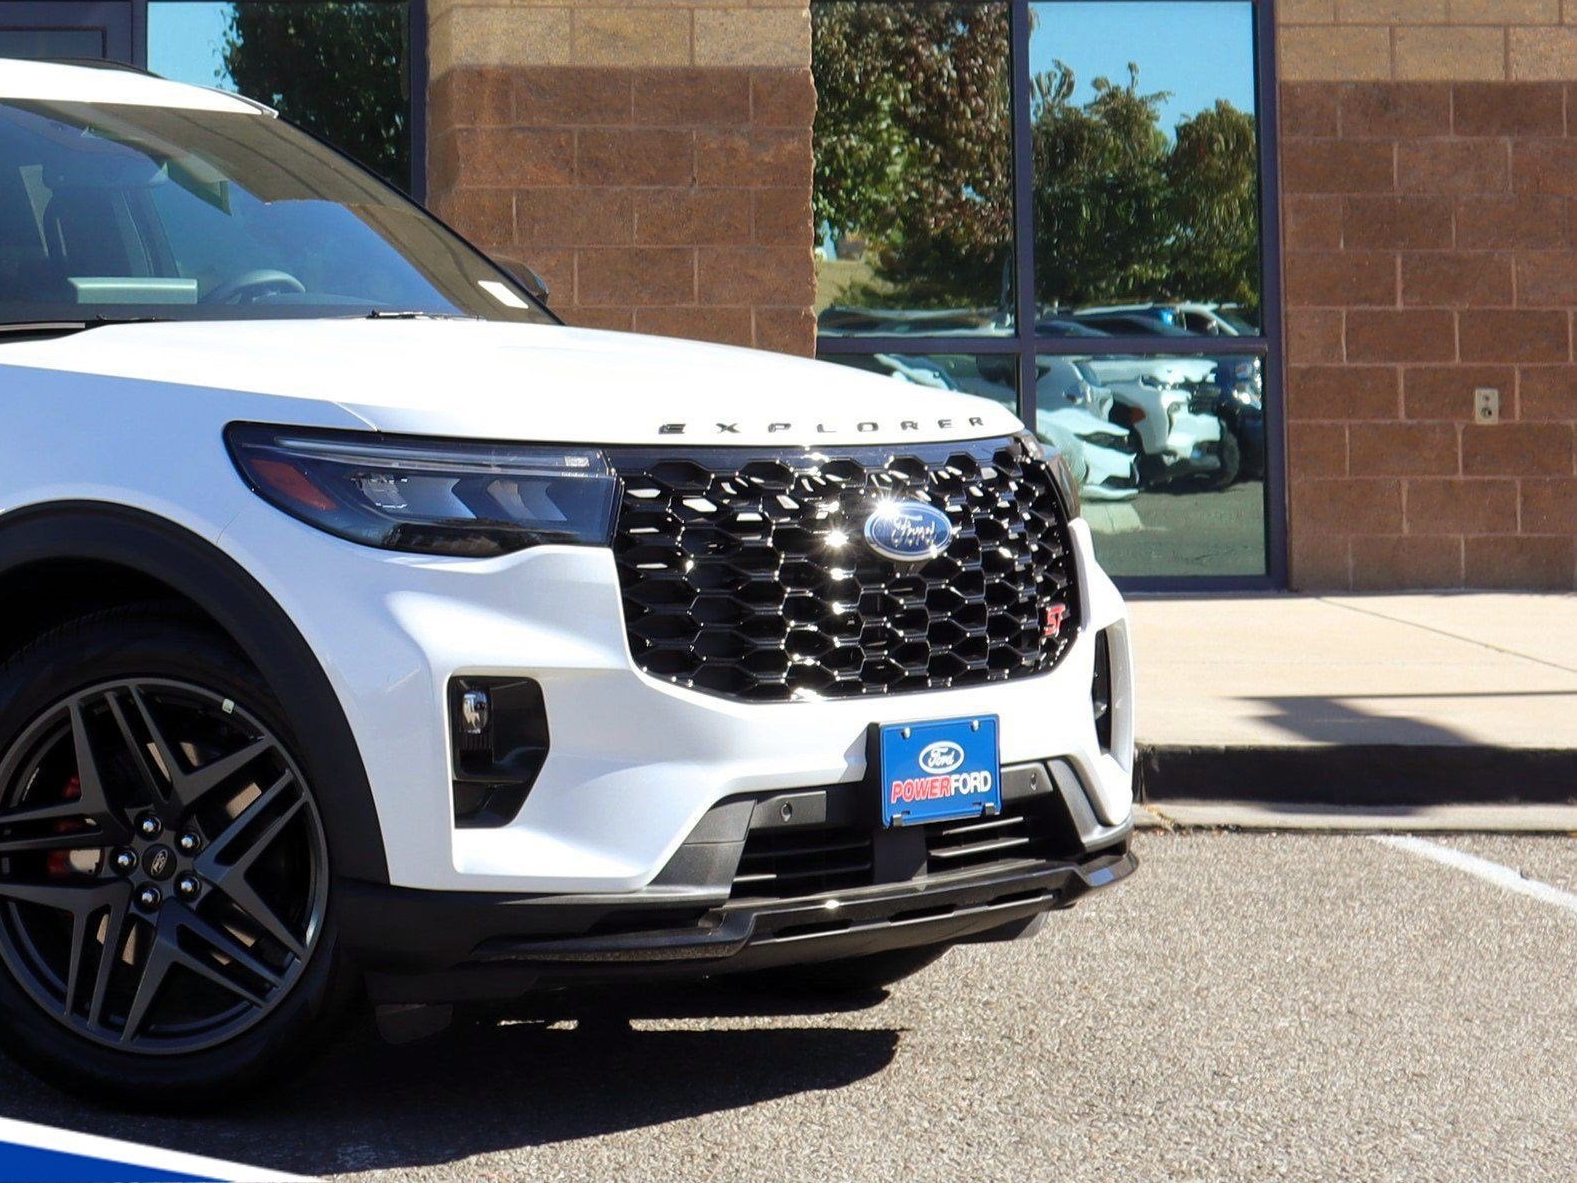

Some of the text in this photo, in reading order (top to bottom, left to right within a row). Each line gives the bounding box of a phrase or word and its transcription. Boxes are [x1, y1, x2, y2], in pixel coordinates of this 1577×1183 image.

[658, 416, 984, 435] EXPLORER
[891, 514, 937, 548] Ford
[1043, 603, 1066, 638] ST
[927, 746, 955, 768] Ford
[890, 770, 992, 804] POWERFORD
